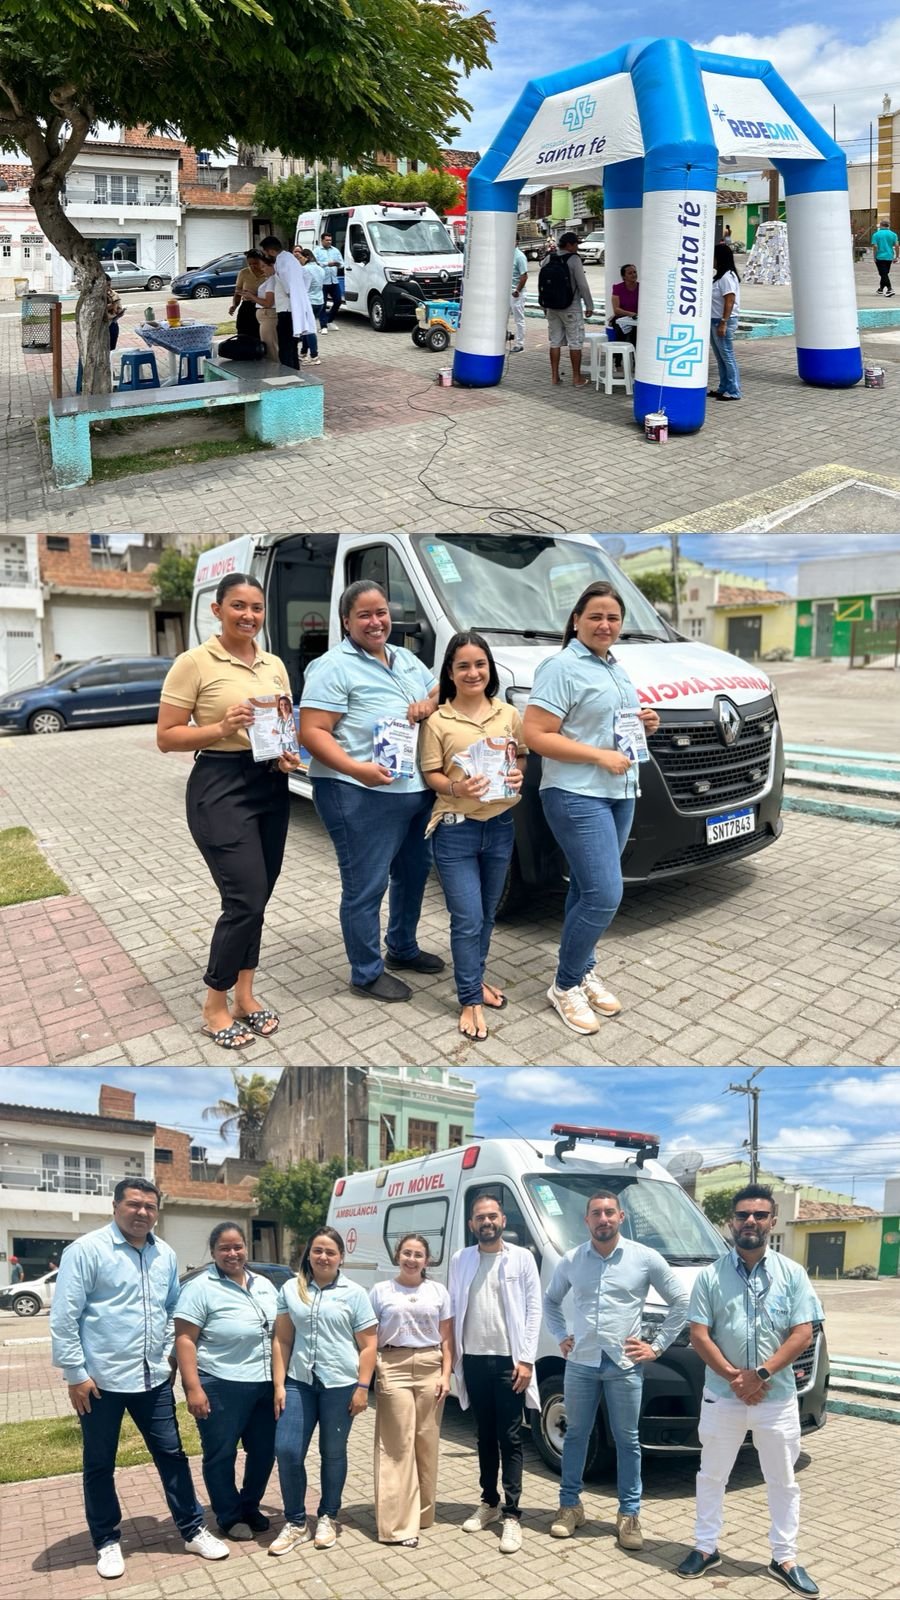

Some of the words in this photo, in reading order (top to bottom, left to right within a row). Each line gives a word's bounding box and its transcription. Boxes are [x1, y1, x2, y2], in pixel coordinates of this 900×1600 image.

[727, 118, 799, 141] REDEDMI
[536, 143, 586, 165] santa
[589, 135, 607, 156] fé
[677, 201, 701, 228] fé
[678, 235, 700, 318] santa
[666, 268, 677, 315] HOSPITAL
[197, 566, 208, 582] UTI
[712, 816, 751, 841] SNT7B43
[387, 1182, 405, 1197] UTI
[408, 1174, 445, 1194] MÓVEL
